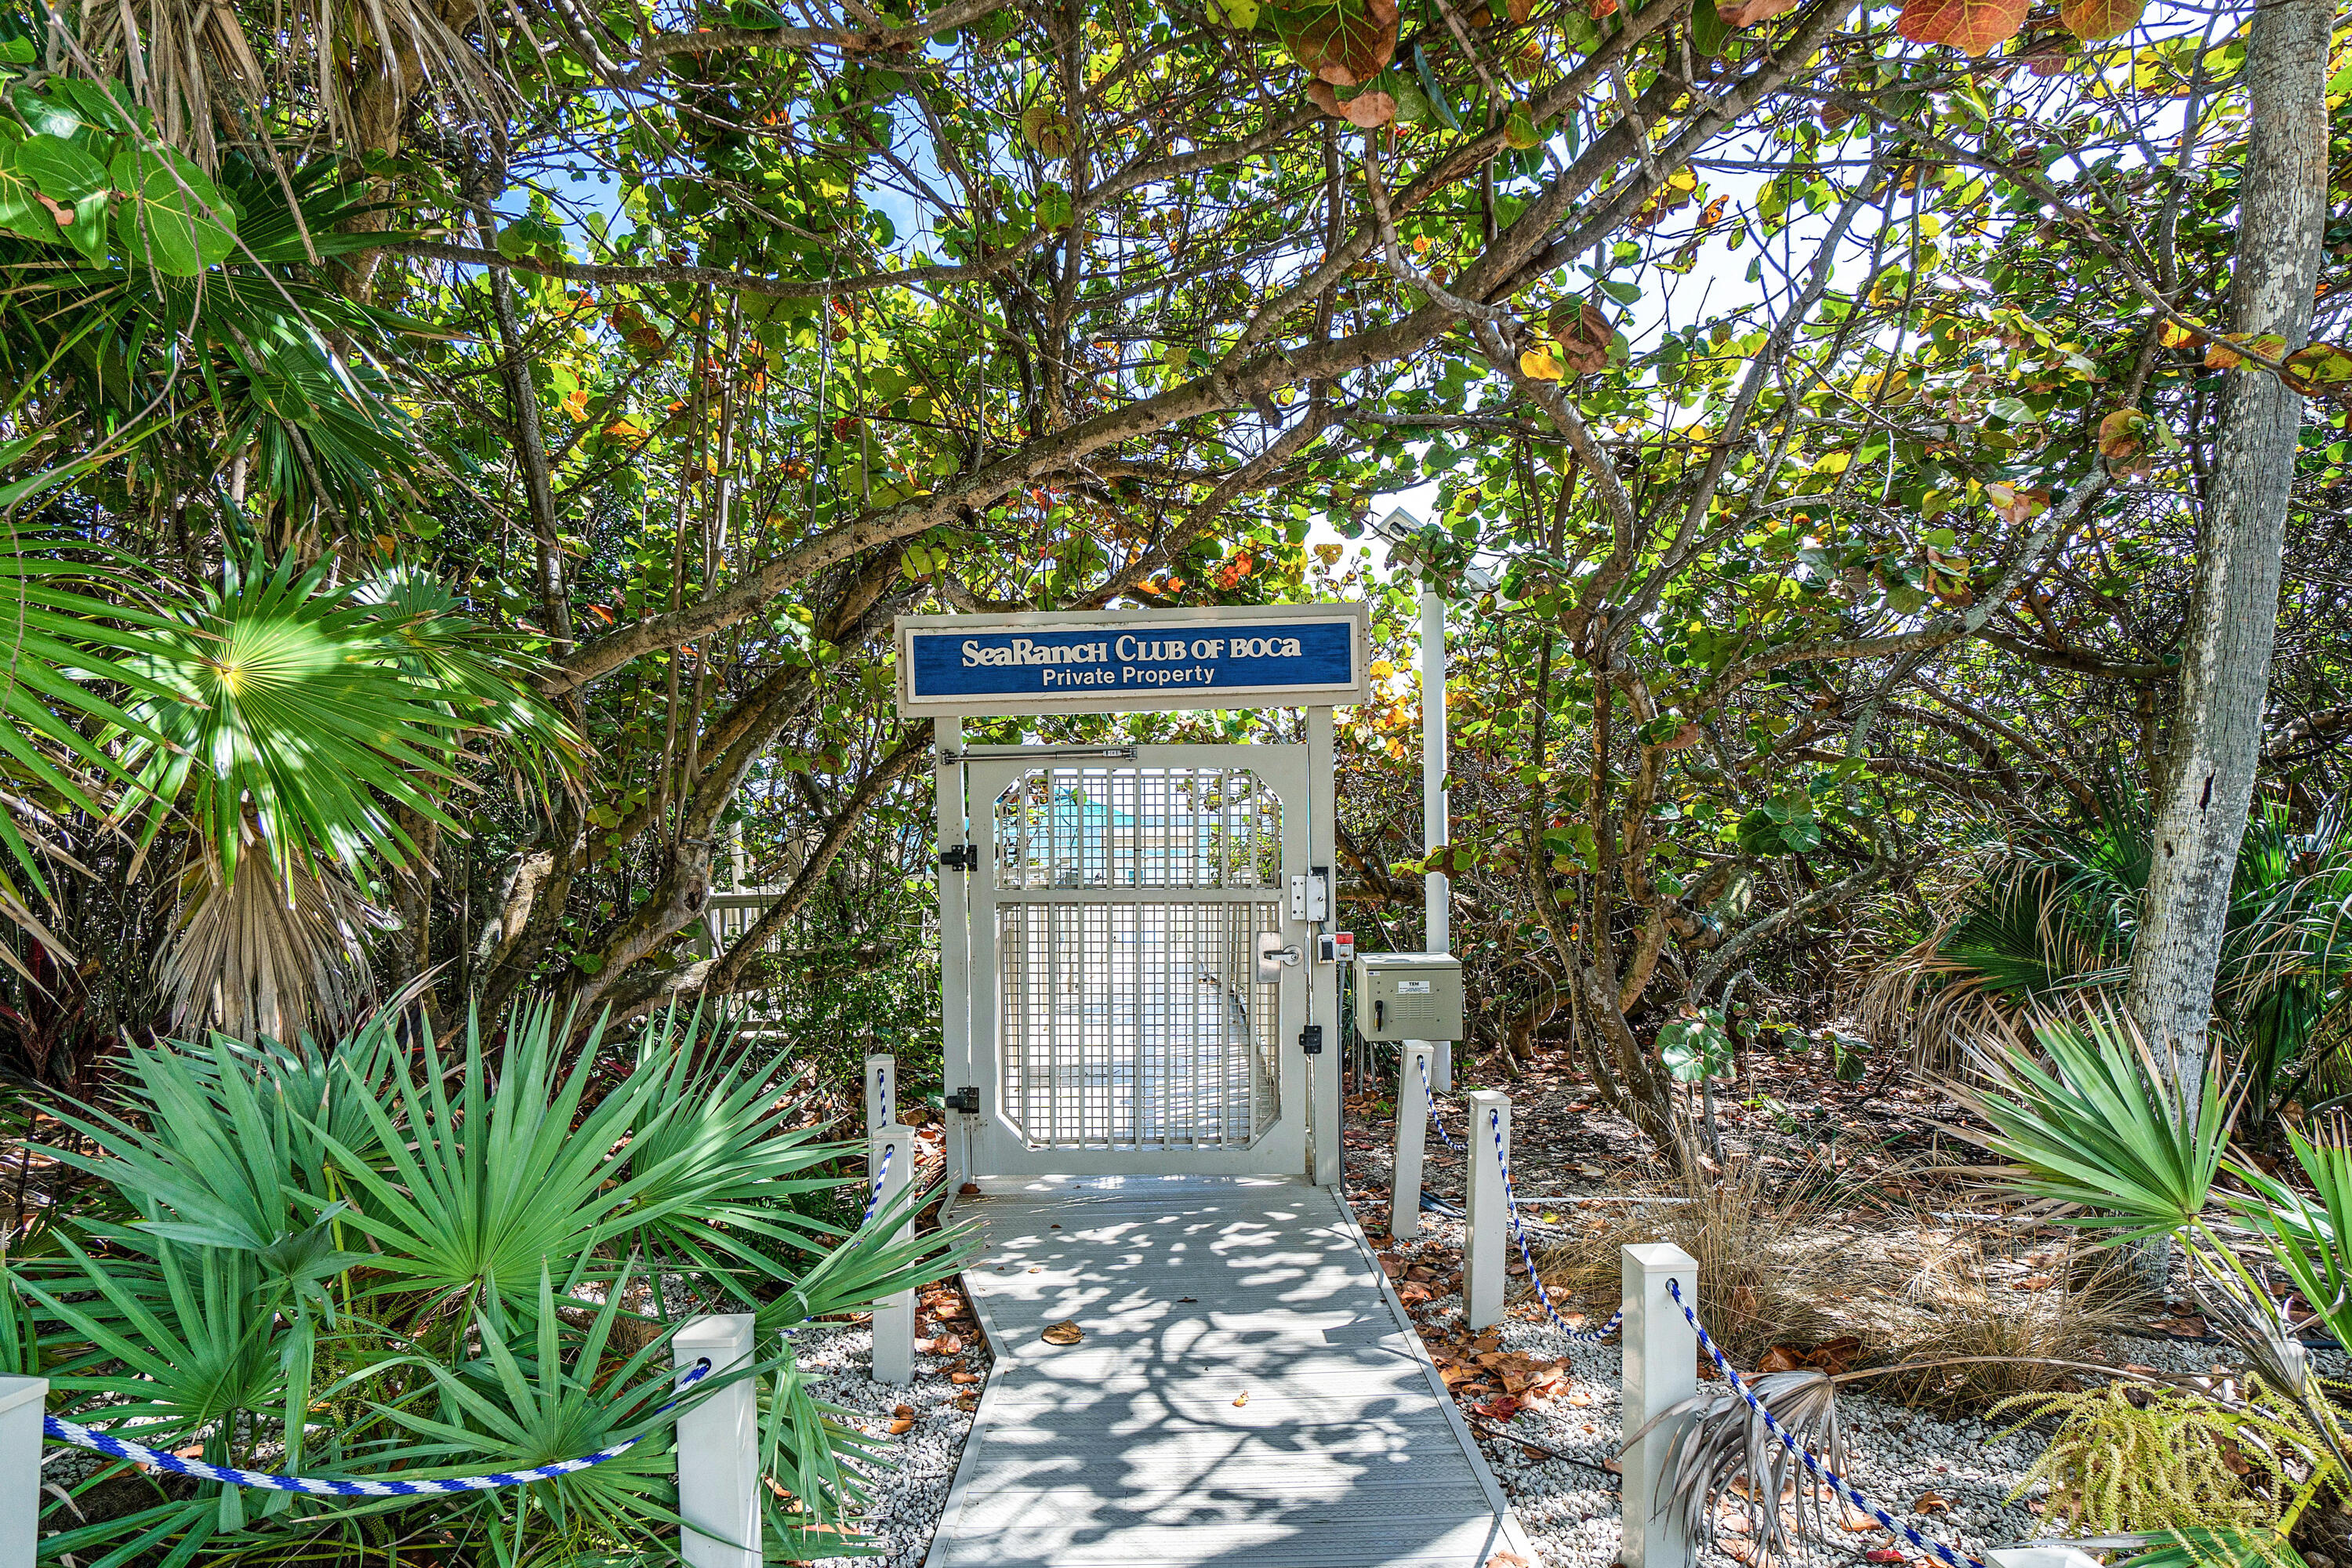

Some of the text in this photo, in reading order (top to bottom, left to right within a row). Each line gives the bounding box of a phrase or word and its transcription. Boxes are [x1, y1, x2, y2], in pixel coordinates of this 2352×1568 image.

[1115, 634, 1188, 662] CLUB
[1043, 665, 1215, 686] Private Property
